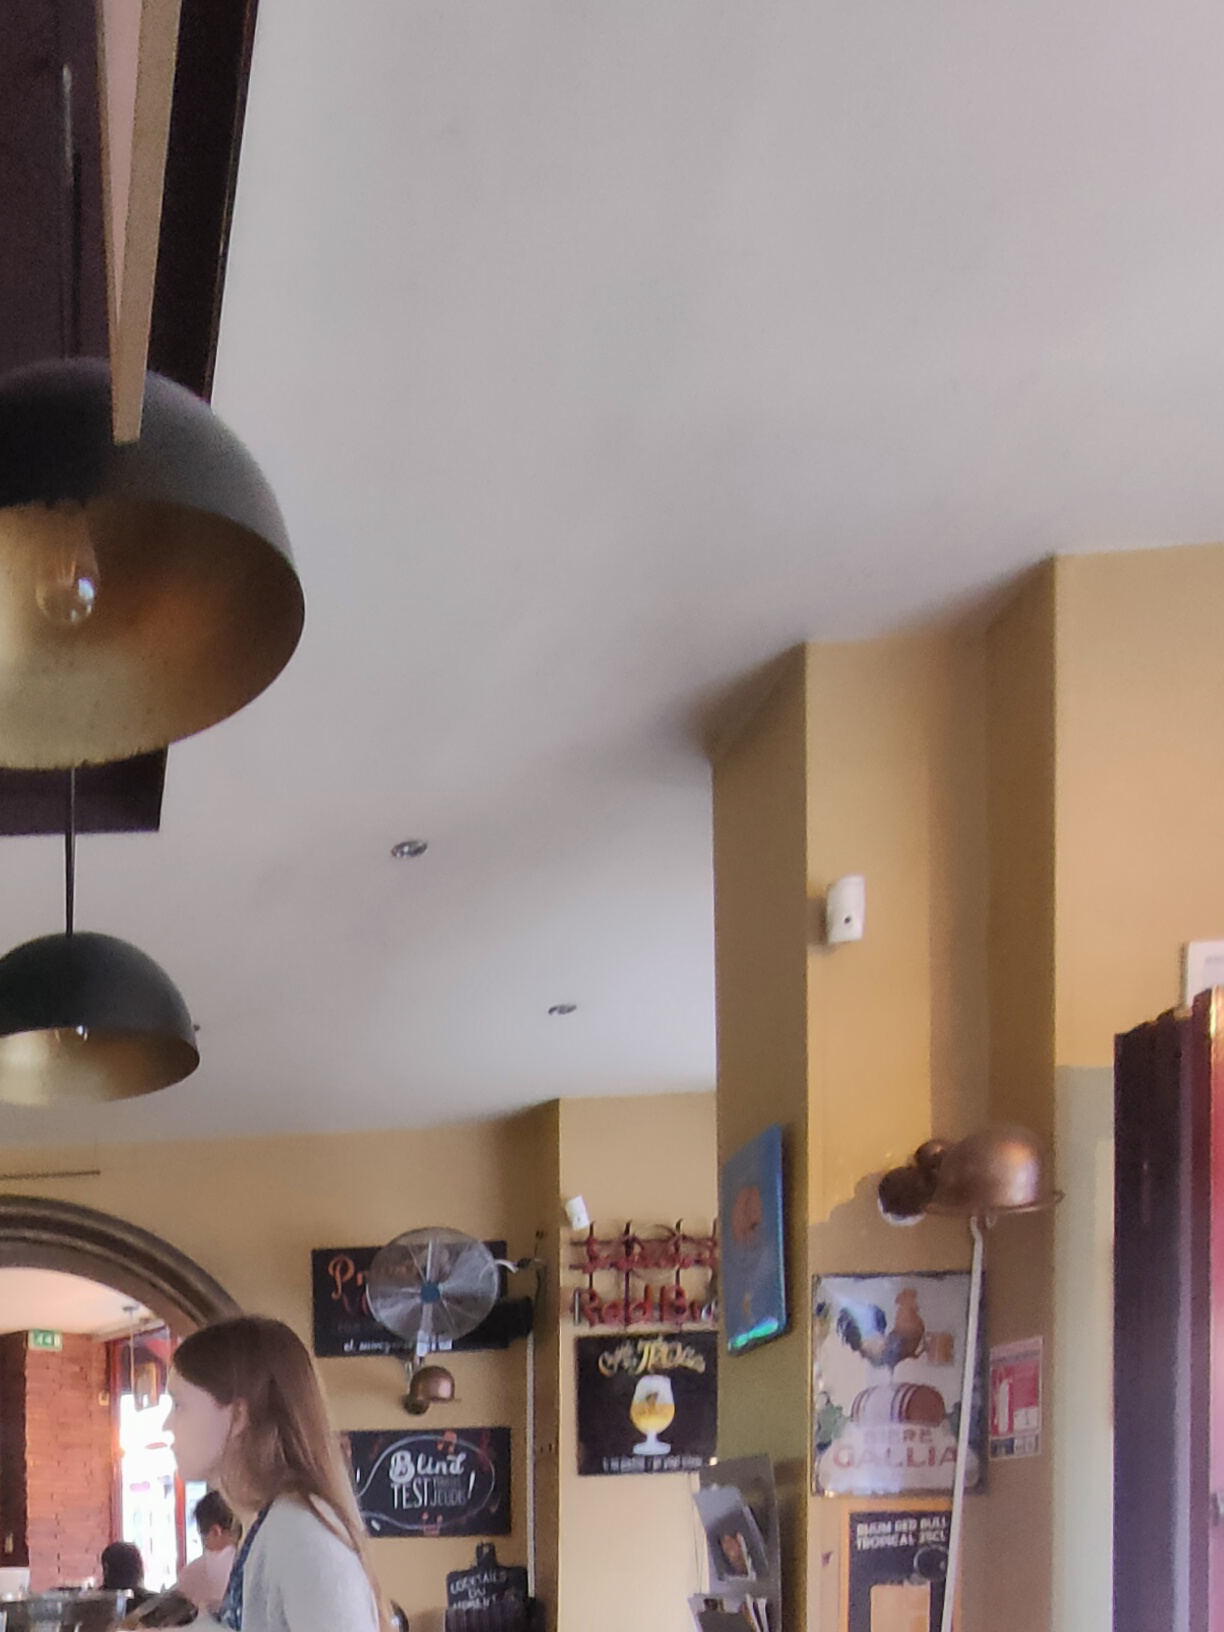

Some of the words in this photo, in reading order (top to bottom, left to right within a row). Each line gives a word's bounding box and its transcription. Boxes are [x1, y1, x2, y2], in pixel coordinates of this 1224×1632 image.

[389, 1450, 467, 1484] Blind
[832, 1445, 957, 1470] GALLIA
[391, 1476, 434, 1510] TEST
